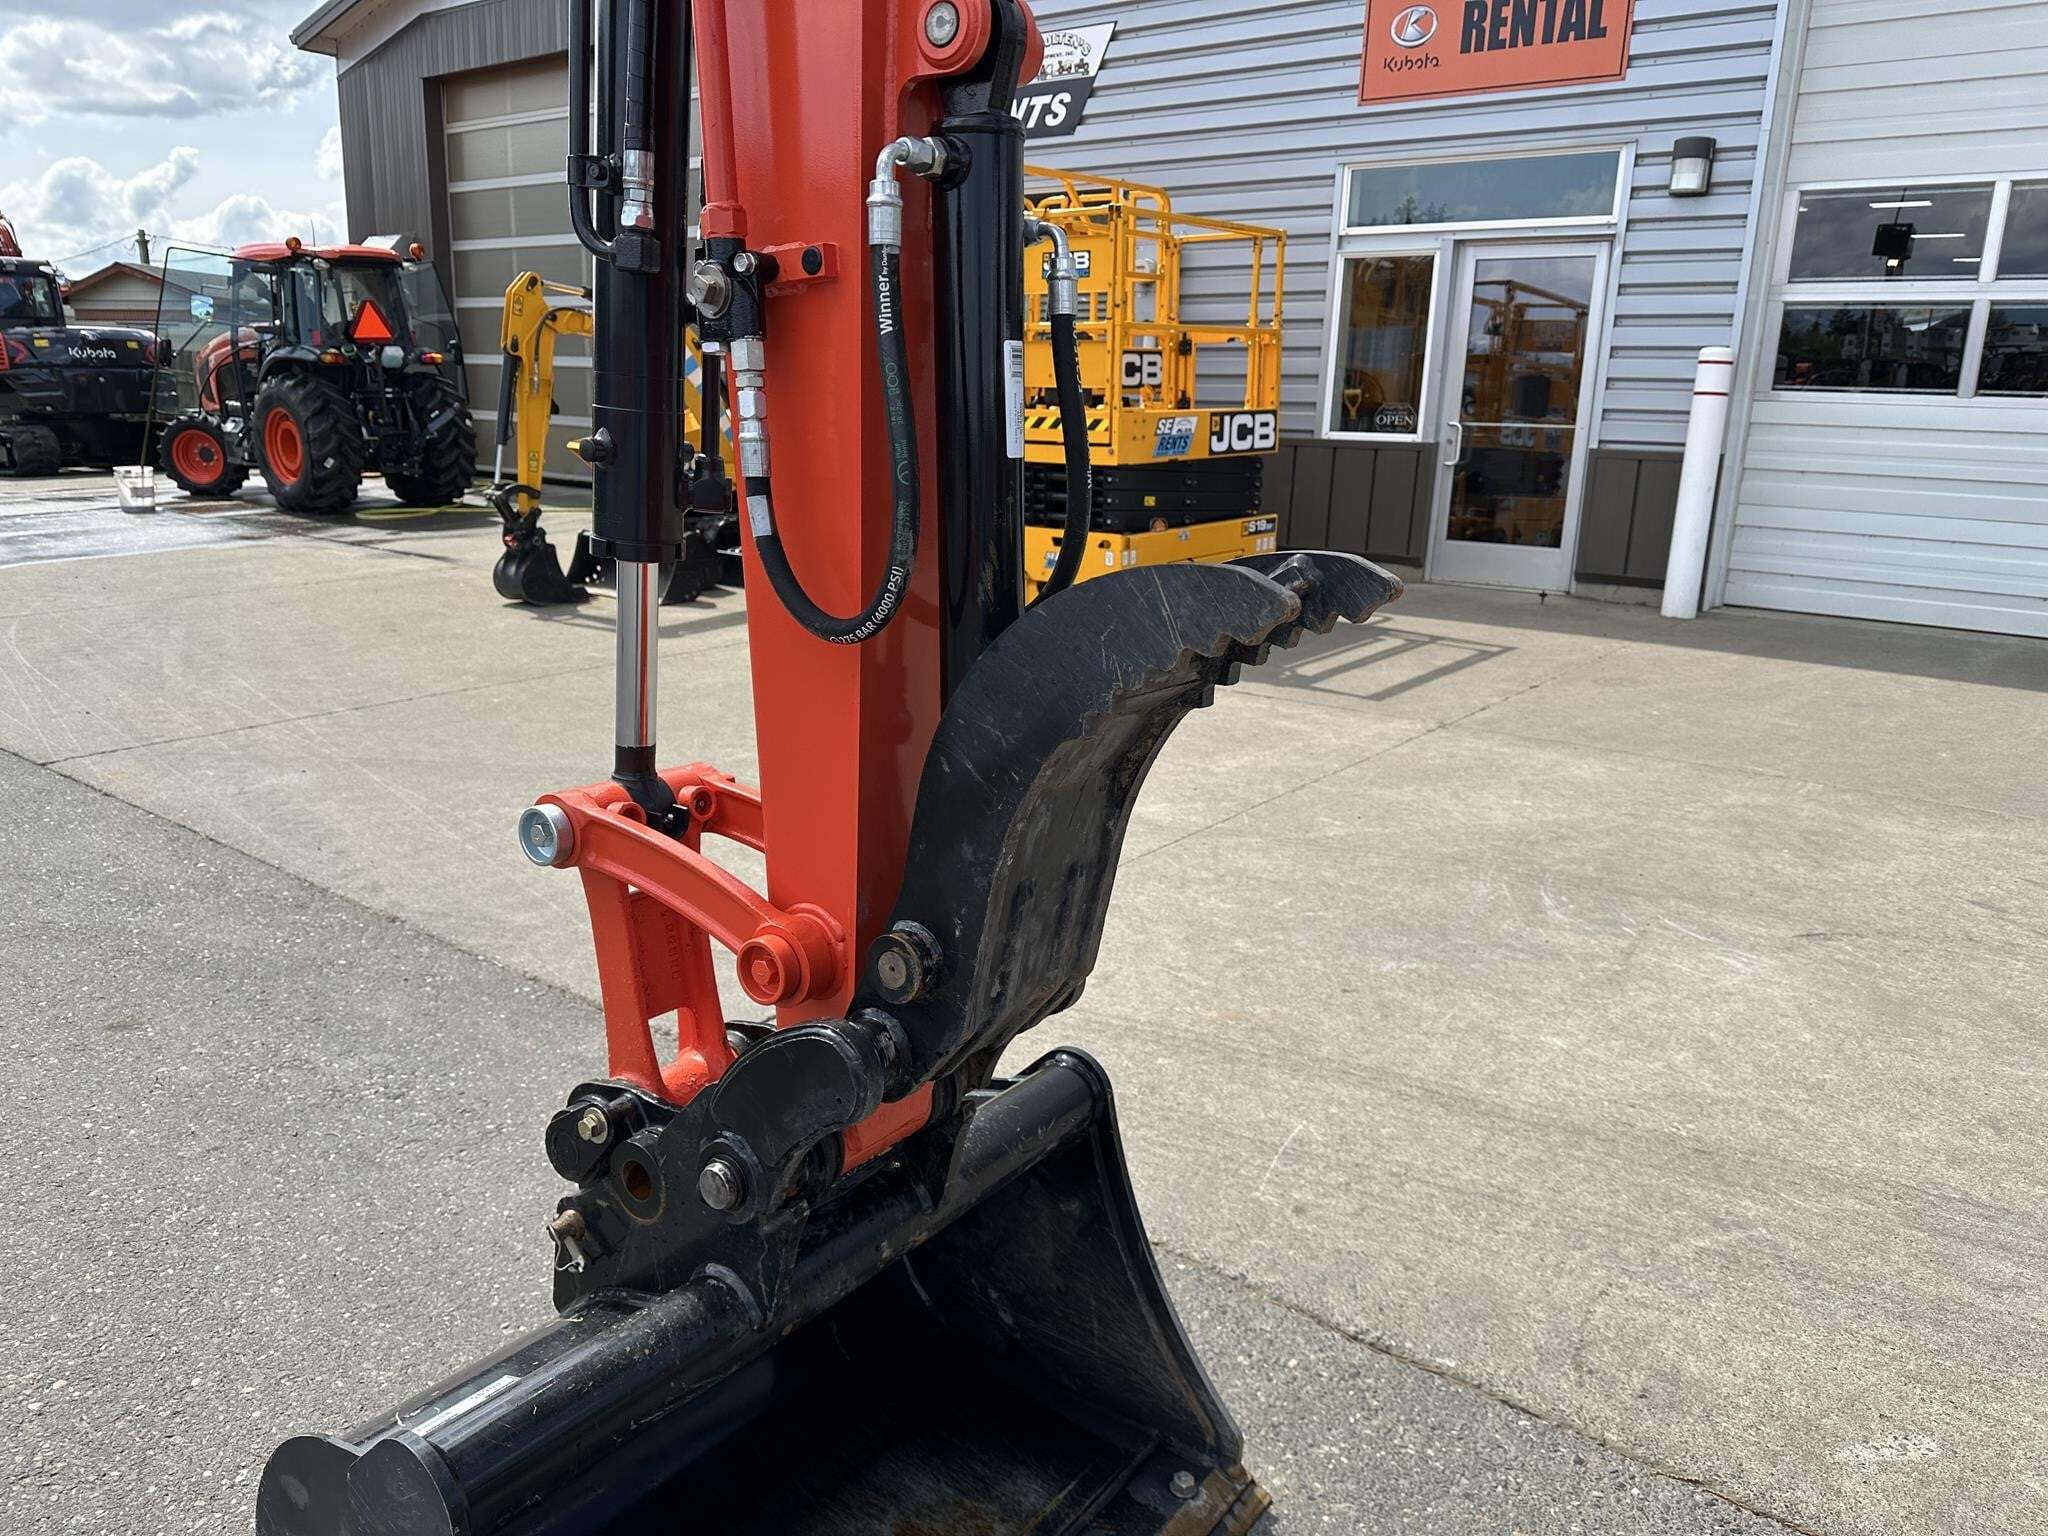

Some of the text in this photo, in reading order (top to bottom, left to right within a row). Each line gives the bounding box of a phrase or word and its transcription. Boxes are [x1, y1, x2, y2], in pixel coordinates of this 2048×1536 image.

[1459, 0, 1608, 54] RENTAL
[1383, 52, 1440, 73] Kubota
[878, 274, 894, 335] Winner
[67, 346, 117, 359] Kubota
[1156, 418, 1174, 434] SE
[1376, 414, 1415, 426] OPEN
[1157, 434, 1191, 452] RENTS
[1211, 413, 1277, 453] JCB
[855, 621, 878, 639] BAR
[871, 593, 895, 624] (4000
[887, 566, 905, 592] PSI)
